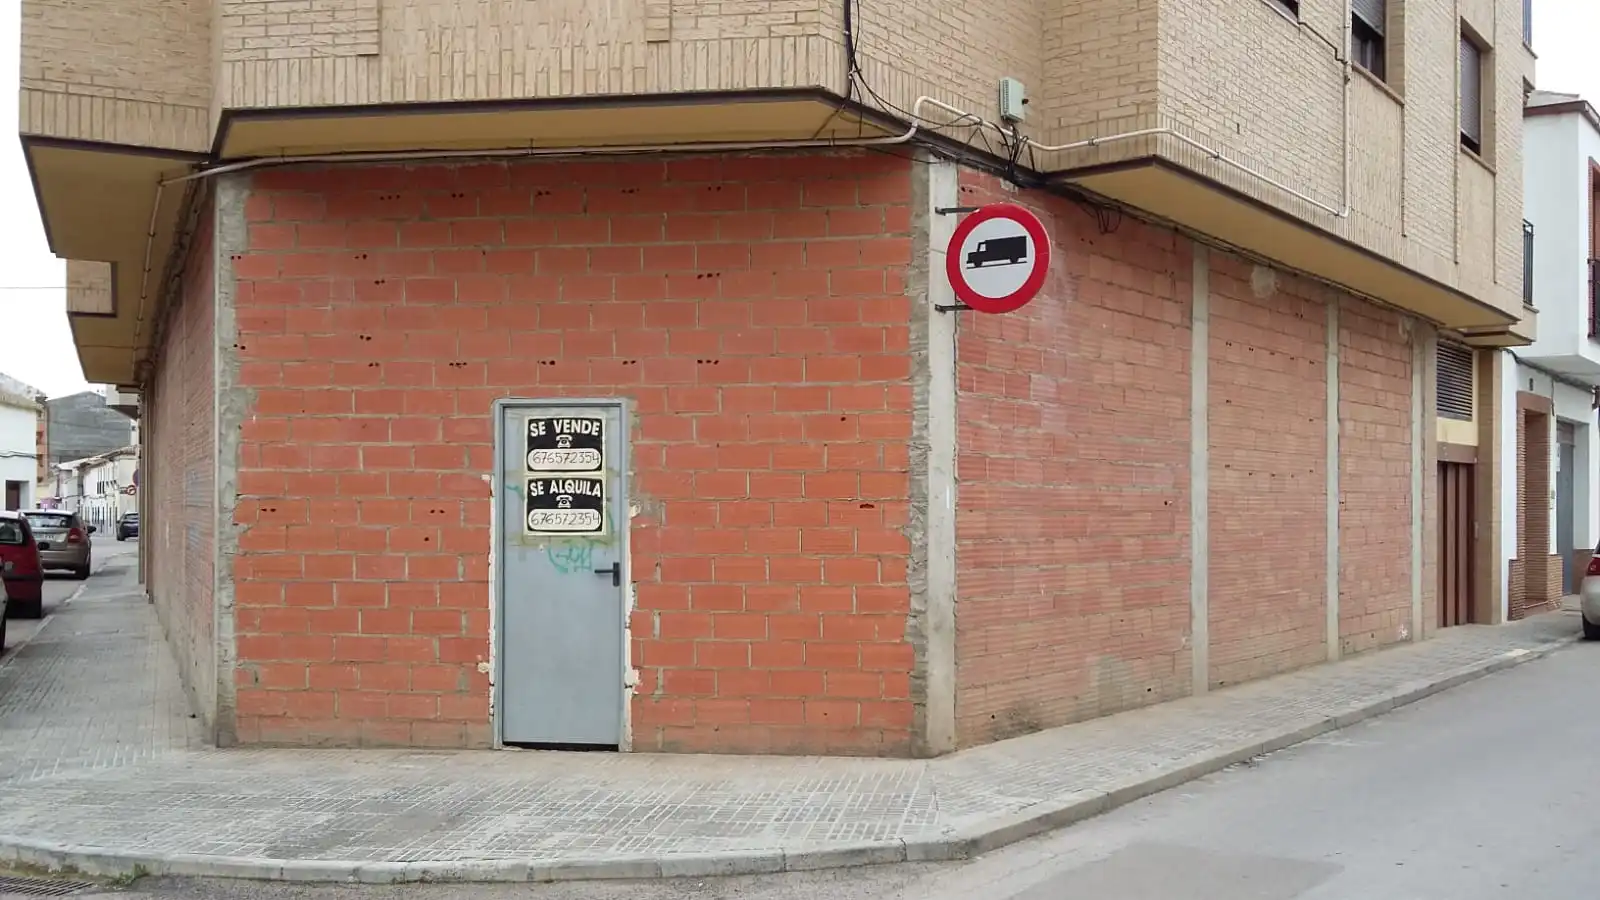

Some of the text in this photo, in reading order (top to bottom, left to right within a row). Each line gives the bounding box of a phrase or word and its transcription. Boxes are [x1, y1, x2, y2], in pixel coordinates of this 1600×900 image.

[530, 419, 600, 437] SE VENDE
[532, 451, 600, 464] 676572354
[530, 480, 601, 497] SE ALQUILA
[531, 512, 600, 526] 676572354
